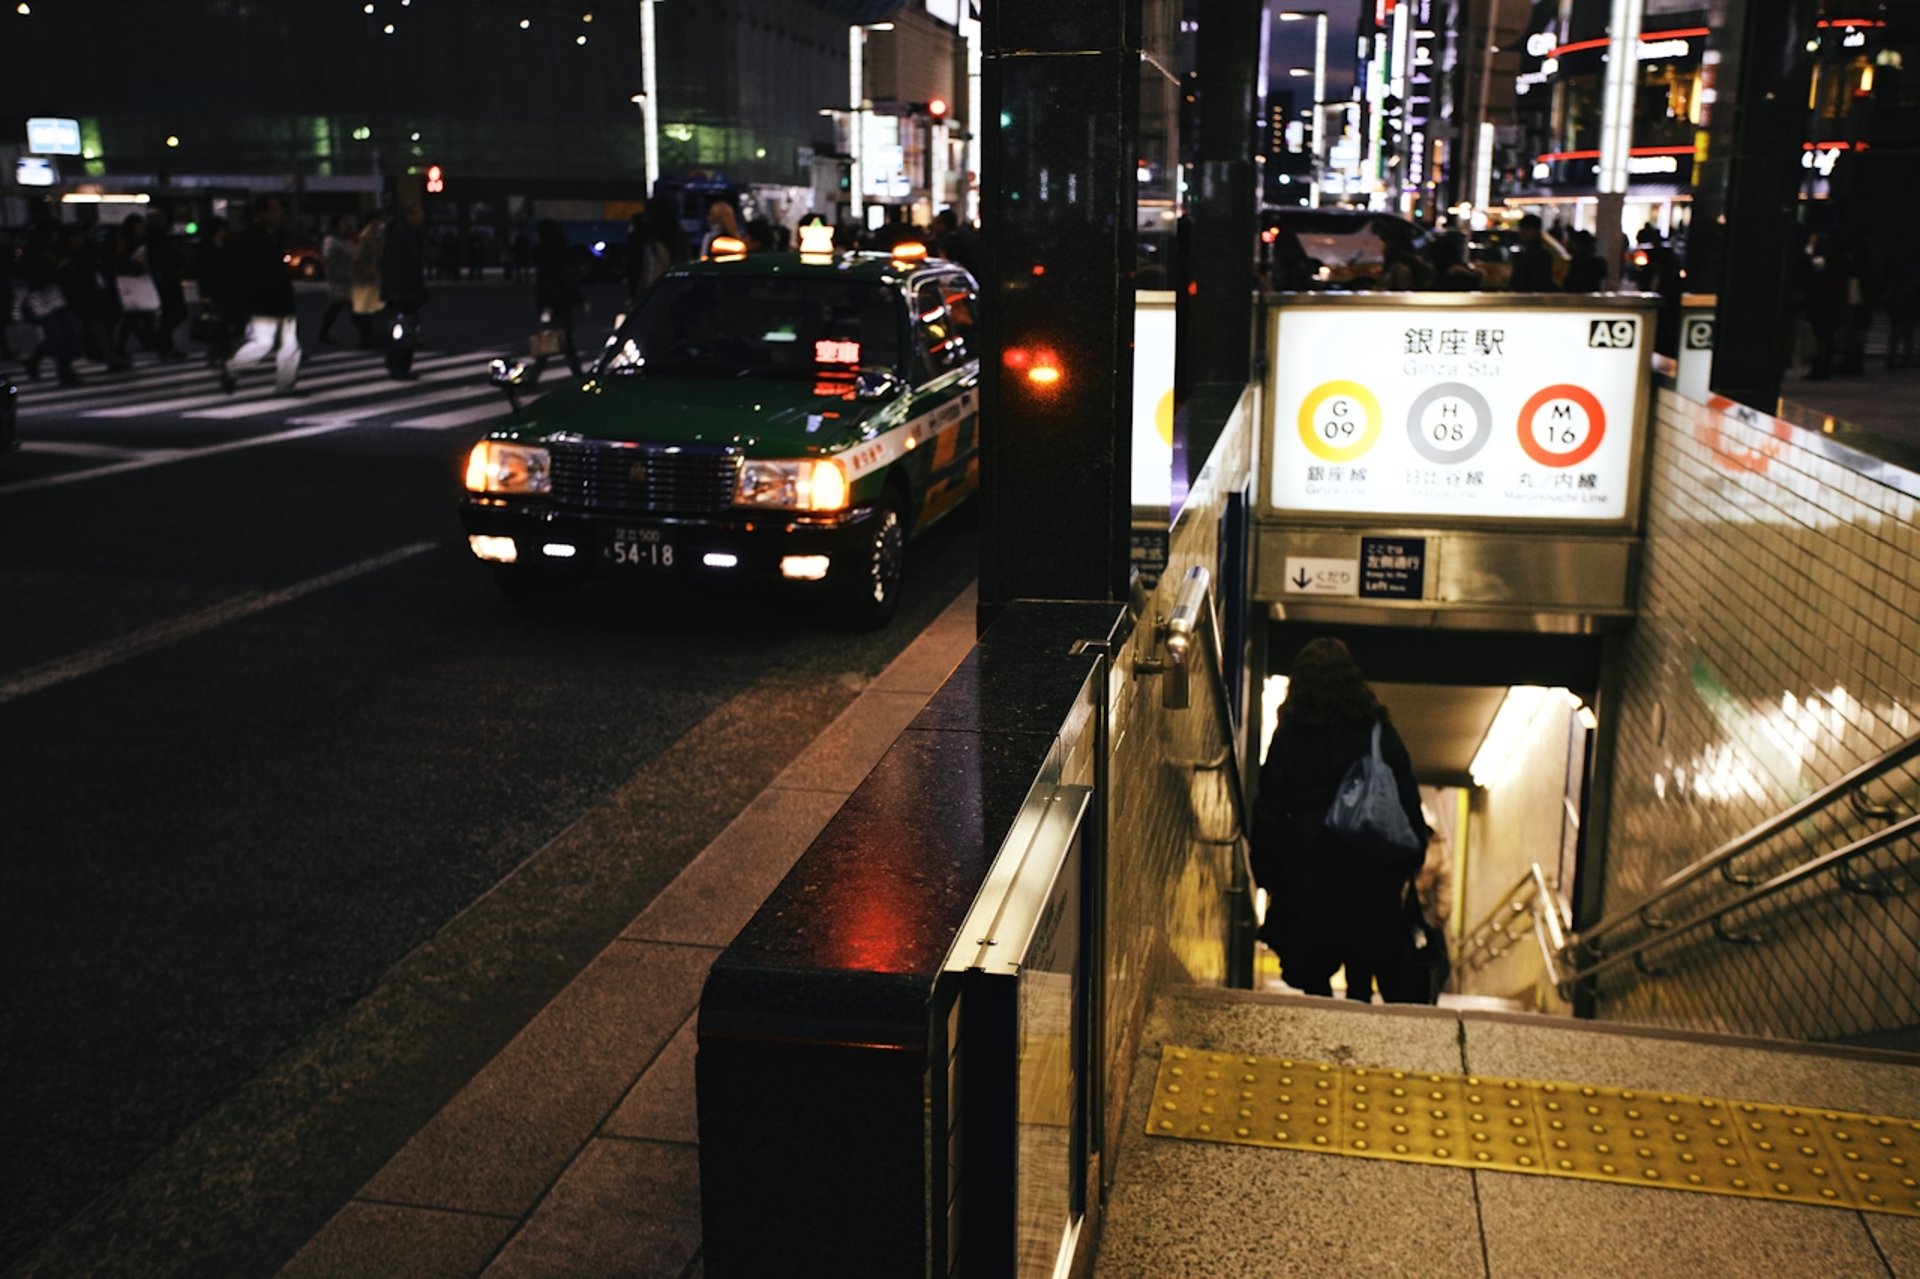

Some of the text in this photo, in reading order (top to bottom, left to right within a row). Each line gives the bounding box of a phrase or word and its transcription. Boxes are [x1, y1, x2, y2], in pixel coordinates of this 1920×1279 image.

[1404, 329, 1504, 356] 銀座駅
[1590, 320, 1635, 348] A9
[1403, 359, 1458, 377] Ginza
[1332, 400, 1348, 417] G
[1442, 403, 1457, 418] H
[1551, 405, 1573, 420] M
[1324, 422, 1355, 440] 09
[1433, 423, 1464, 442] 08
[1547, 426, 1576, 443] 16
[614, 541, 674, 567] 54-18
[1316, 571, 1350, 584] くだり
